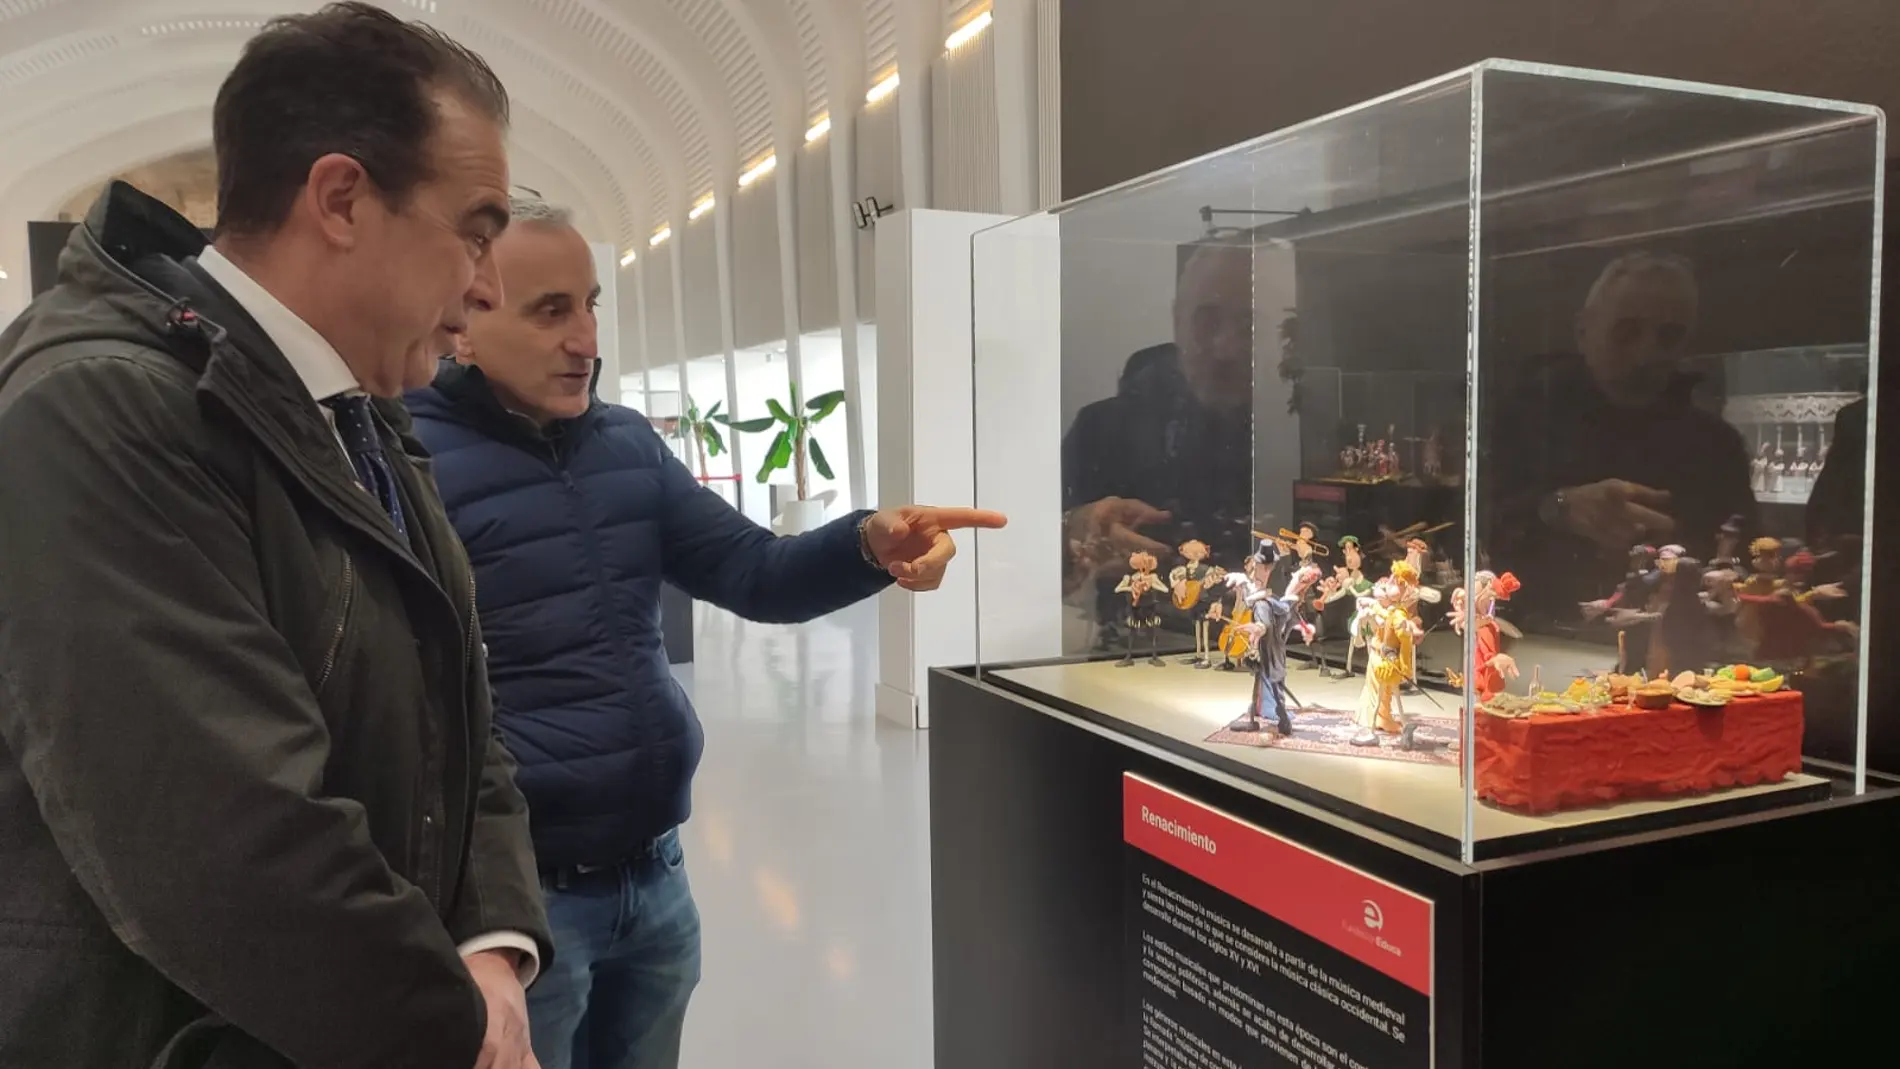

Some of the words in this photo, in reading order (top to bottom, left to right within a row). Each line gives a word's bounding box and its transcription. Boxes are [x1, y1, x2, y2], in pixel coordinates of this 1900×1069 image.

[1141, 804, 1216, 854] Renacimiento
[1142, 873, 1149, 885] En
[1150, 880, 1156, 889] el
[1157, 881, 1198, 912] Renacimiento
[1206, 910, 1230, 929] música
[1231, 923, 1240, 935] se
[1241, 927, 1276, 955] desarrolla
[1285, 952, 1304, 970] partir
[1307, 963, 1318, 978] de
[1319, 969, 1326, 983] la
[1329, 976, 1360, 1001] música
[1362, 994, 1404, 1025] medieval
[1143, 930, 1153, 944] Los
[1154, 938, 1173, 956] estilos
[1174, 951, 1206, 977] musicales
[1207, 971, 1220, 986] que
[1222, 980, 1264, 1013] predominan
[1266, 1007, 1275, 1020] en
[1277, 1014, 1293, 1031] esta
[1295, 1023, 1319, 1047] época
[1321, 1041, 1337, 1058] son
[1339, 1052, 1347, 1065] el
[1146, 891, 1164, 907] sienta
[1175, 905, 1193, 923] bases
[1195, 916, 1202, 928] de
[1211, 927, 1223, 940] que
[1225, 934, 1233, 946] se
[1234, 940, 1269, 966] considera
[1271, 958, 1277, 971] la
[1279, 965, 1307, 988] música
[1309, 981, 1338, 1005] clásica
[1340, 999, 1390, 1034] occidental.
[1392, 1025, 1404, 1043] Se
[1172, 916, 1195, 938] durante
[1196, 930, 1206, 945] los
[1208, 939, 1227, 957] siglos
[1229, 949, 1239, 964] XV
[1246, 959, 1260, 976] XVI.
[1142, 957, 1180, 988] composición
[1182, 981, 1205, 1004] basado
[1207, 999, 1216, 1012] en
[1218, 1006, 1242, 1028] modos
[1245, 1023, 1258, 1039] que
[1260, 1033, 1298, 1065] provienen
[1143, 998, 1153, 1014] Los
[1154, 1008, 1177, 1031] géneros
[1178, 1025, 1210, 1055] musicales
[1211, 1048, 1220, 1062] en
[1147, 946, 1153, 957] la
[1155, 951, 1176, 972] textura
[1213, 988, 1240, 1013] además
[1242, 1007, 1251, 1020] se
[1253, 1014, 1275, 1035] acaba
[1279, 1028, 1288, 1044] de
[1291, 1036, 1334, 1069] desarrollar
